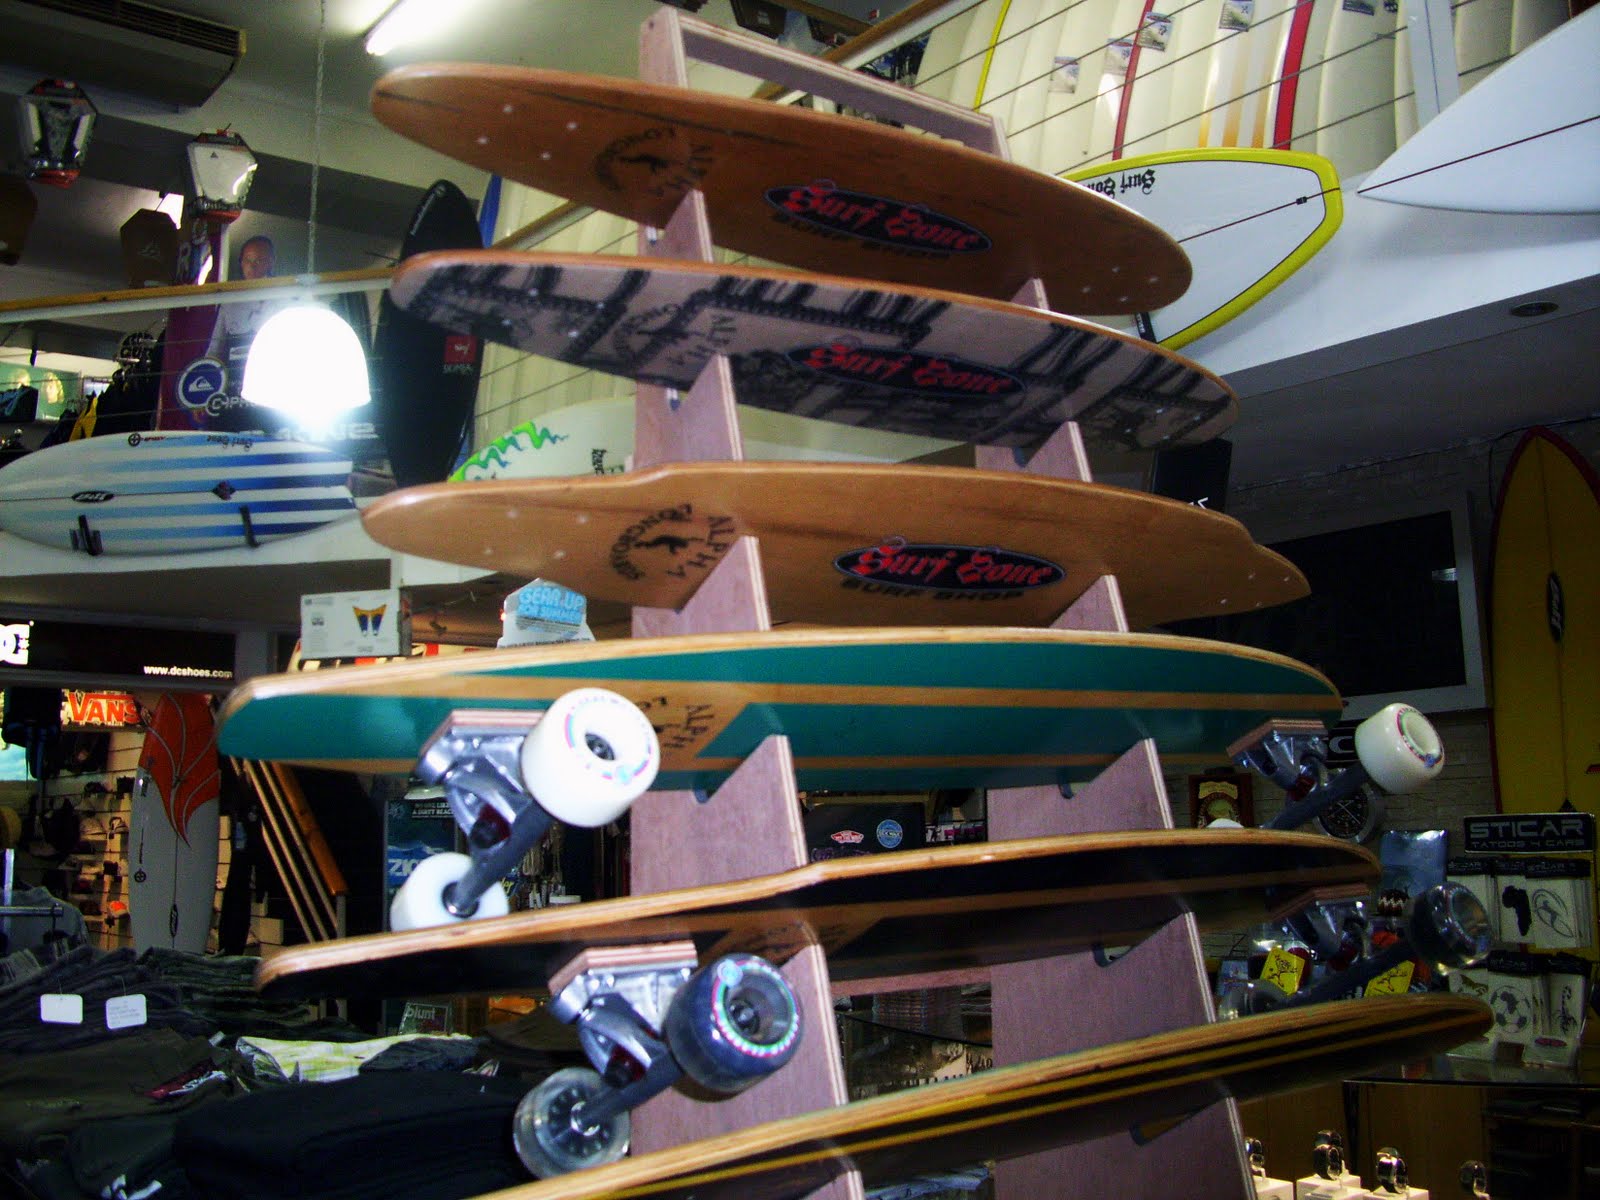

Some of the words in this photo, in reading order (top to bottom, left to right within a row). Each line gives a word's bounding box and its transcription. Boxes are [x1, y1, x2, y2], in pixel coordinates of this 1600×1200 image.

[1120, 168, 1156, 195] Surf
[783, 179, 886, 231] Surf
[886, 208, 979, 250] Zone
[803, 340, 912, 381] Surf
[852, 537, 957, 582] Surf
[957, 549, 1052, 584] Zone
[144, 665, 233, 679] www.dcshoes.com
[68, 691, 142, 725] VANS
[1470, 818, 1585, 839] STICAR
[1545, 839, 1586, 847] CARS
[405, 1004, 436, 1020] blunt
